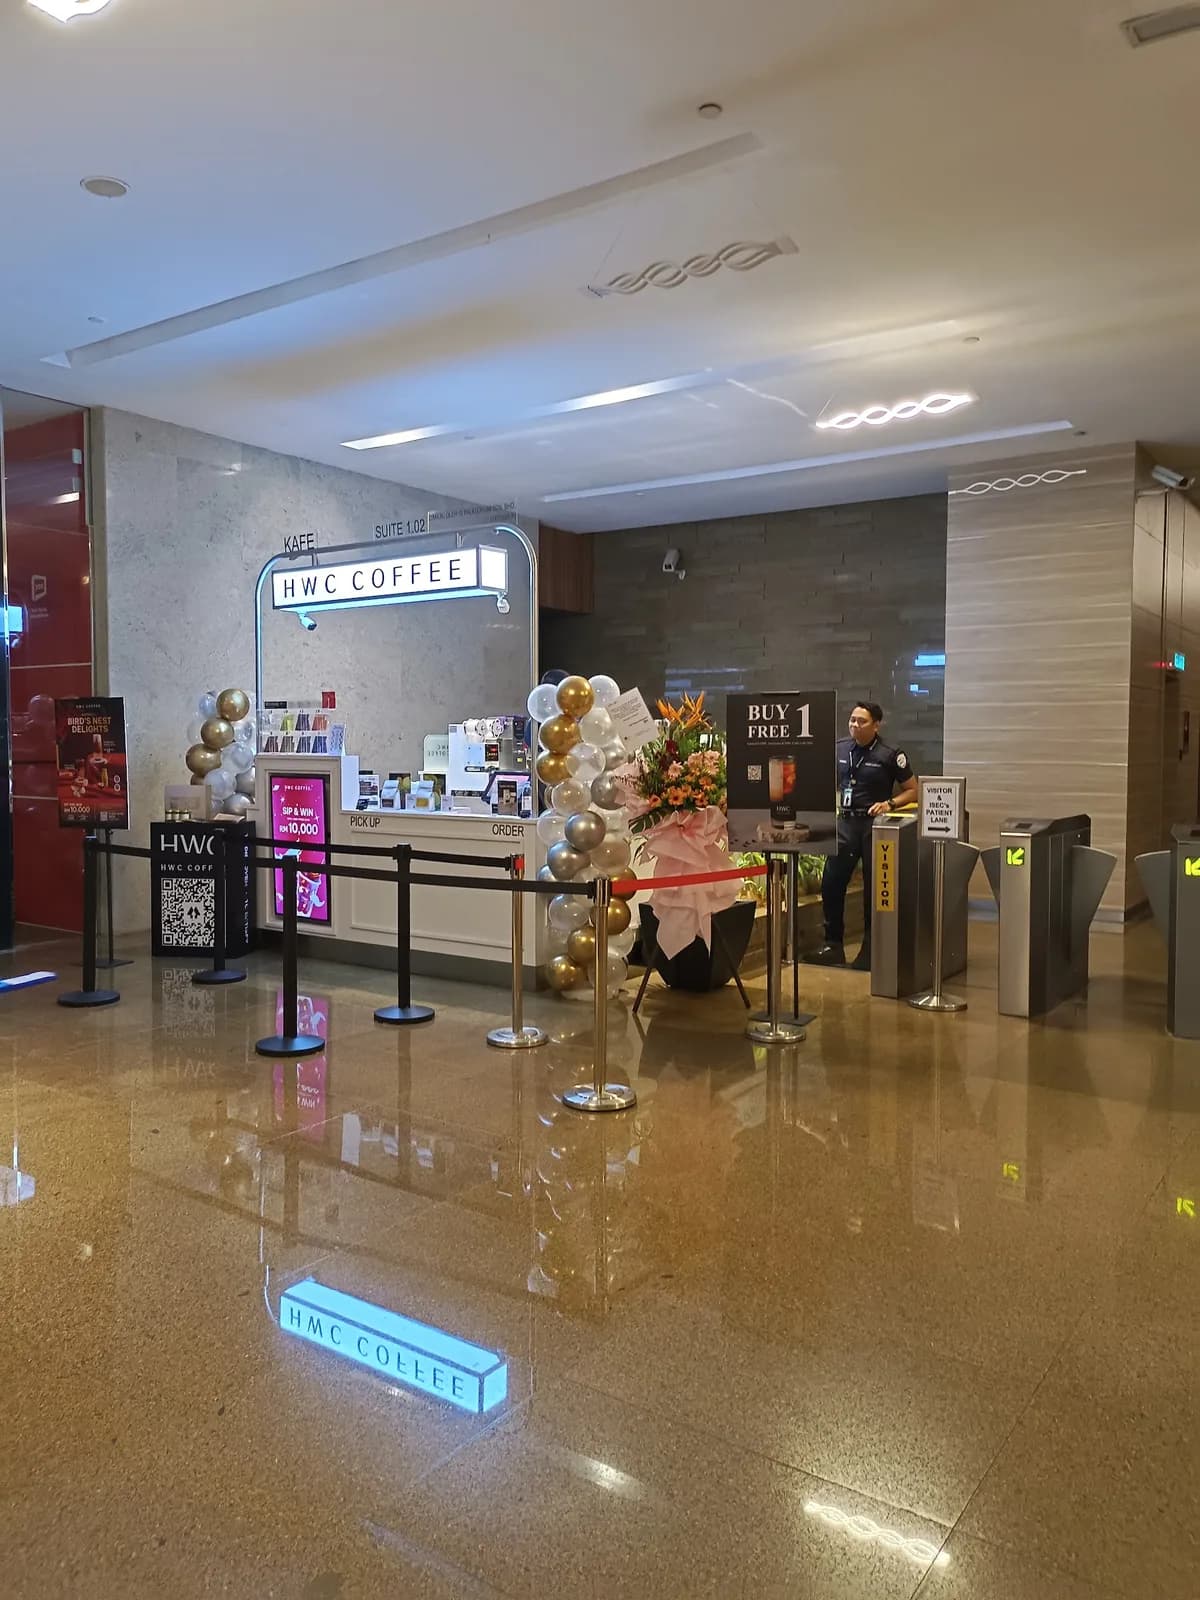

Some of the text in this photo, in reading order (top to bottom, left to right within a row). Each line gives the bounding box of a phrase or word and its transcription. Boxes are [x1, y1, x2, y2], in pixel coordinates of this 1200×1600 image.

[375, 518, 426, 539] SUITE 1.02
[283, 532, 315, 553] KAFE
[283, 558, 462, 599] HWC COFFEE
[748, 703, 790, 721] BUY
[67, 716, 111, 726] BIRD'S NEST
[796, 703, 814, 738] 1
[71, 725, 109, 734] DELIGHTS
[748, 724, 790, 739] FREE
[282, 806, 314, 817] SIP & WIN
[925, 809, 953, 817] PATIENT
[350, 817, 381, 829] PICK UP
[930, 816, 948, 824] LANE
[492, 823, 525, 837] ORDER
[160, 863, 183, 872] HWC
[880, 843, 890, 908] VISITOR
